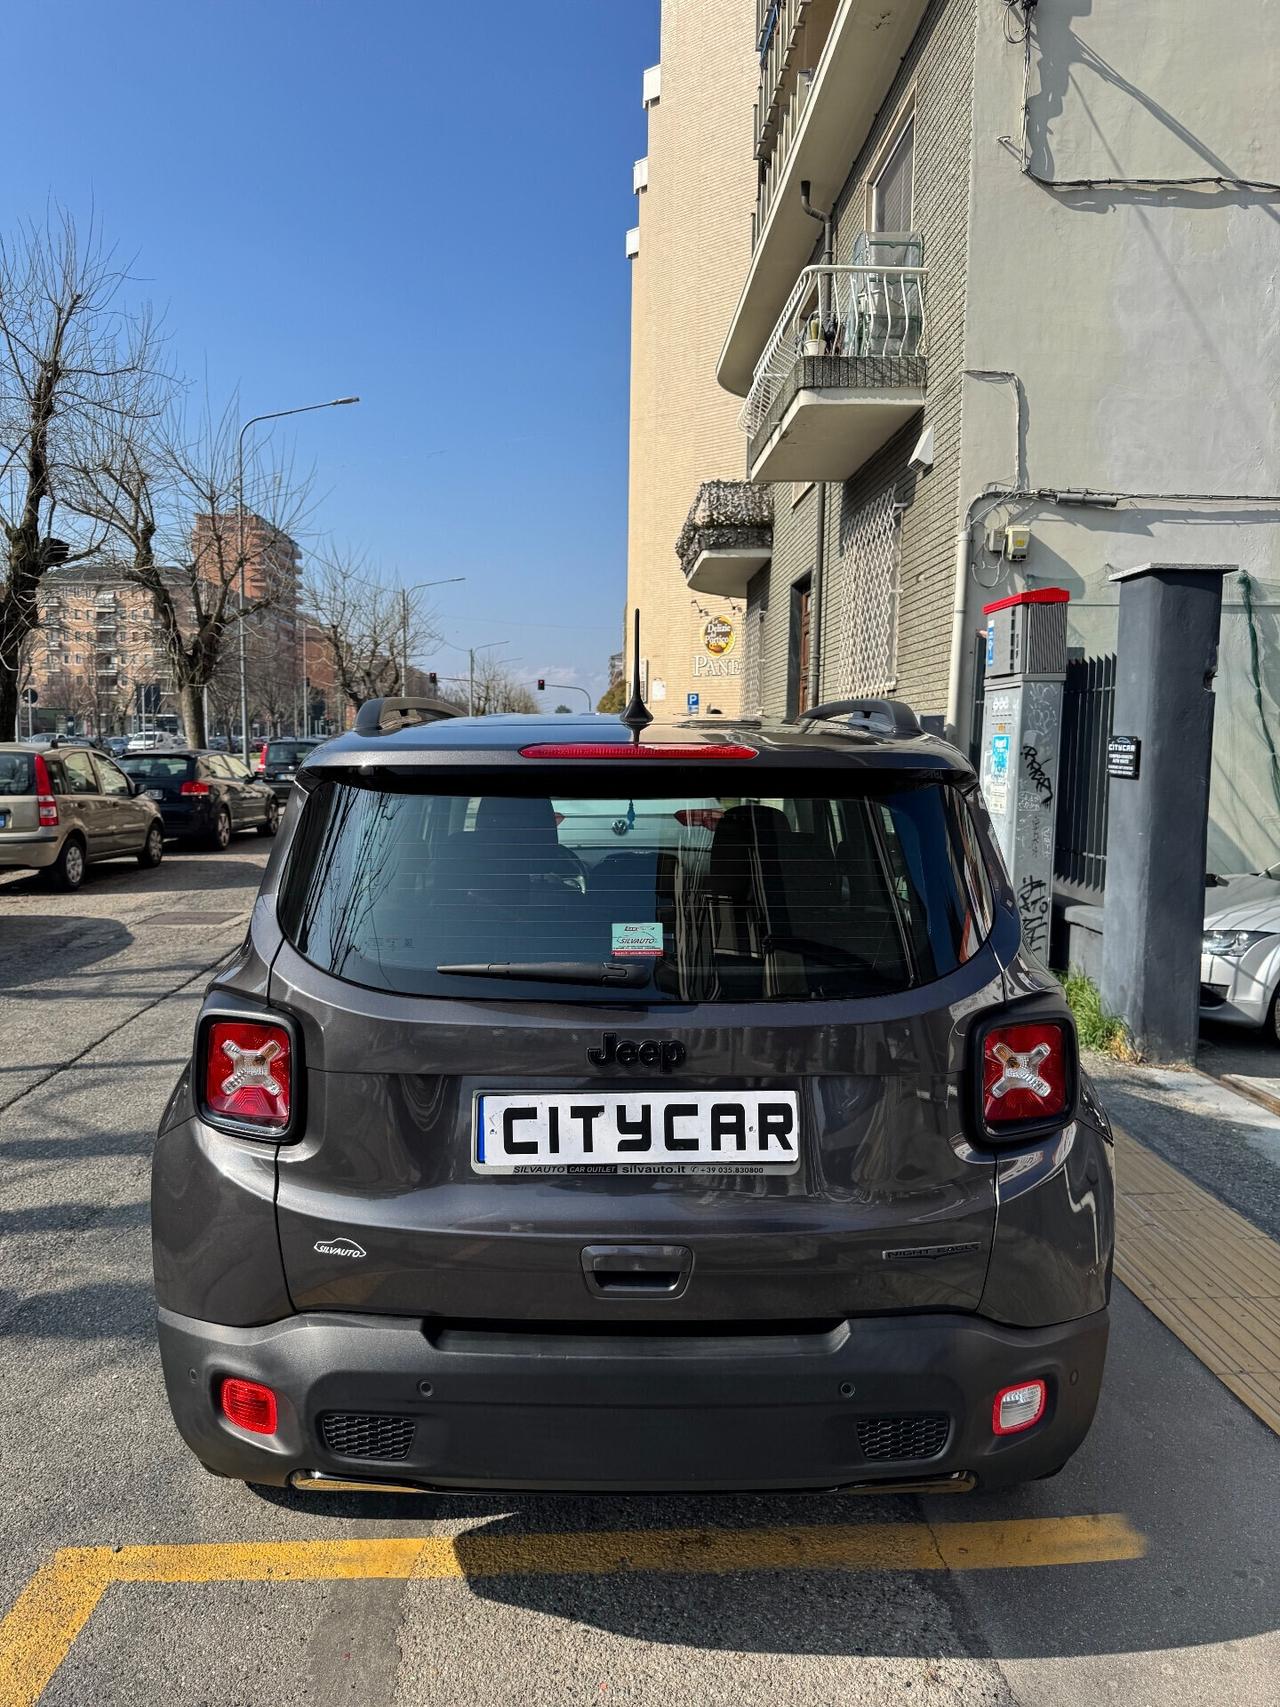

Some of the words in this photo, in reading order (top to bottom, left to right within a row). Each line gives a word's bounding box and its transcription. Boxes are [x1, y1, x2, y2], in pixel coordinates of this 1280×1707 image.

[707, 623, 731, 632] Delizie
[705, 635, 729, 644] Portico
[693, 655, 741, 677] PANE
[689, 695, 697, 704] P
[1108, 744, 1136, 752] CITYCAR
[586, 1032, 687, 1073] Jeep
[502, 1103, 794, 1155] CITYCAR
[513, 1165, 566, 1174] SILVAUTO
[586, 1165, 615, 1173] OUTLET
[622, 1165, 686, 1174] silvauto.it
[319, 1245, 361, 1258] SILVAUTO
